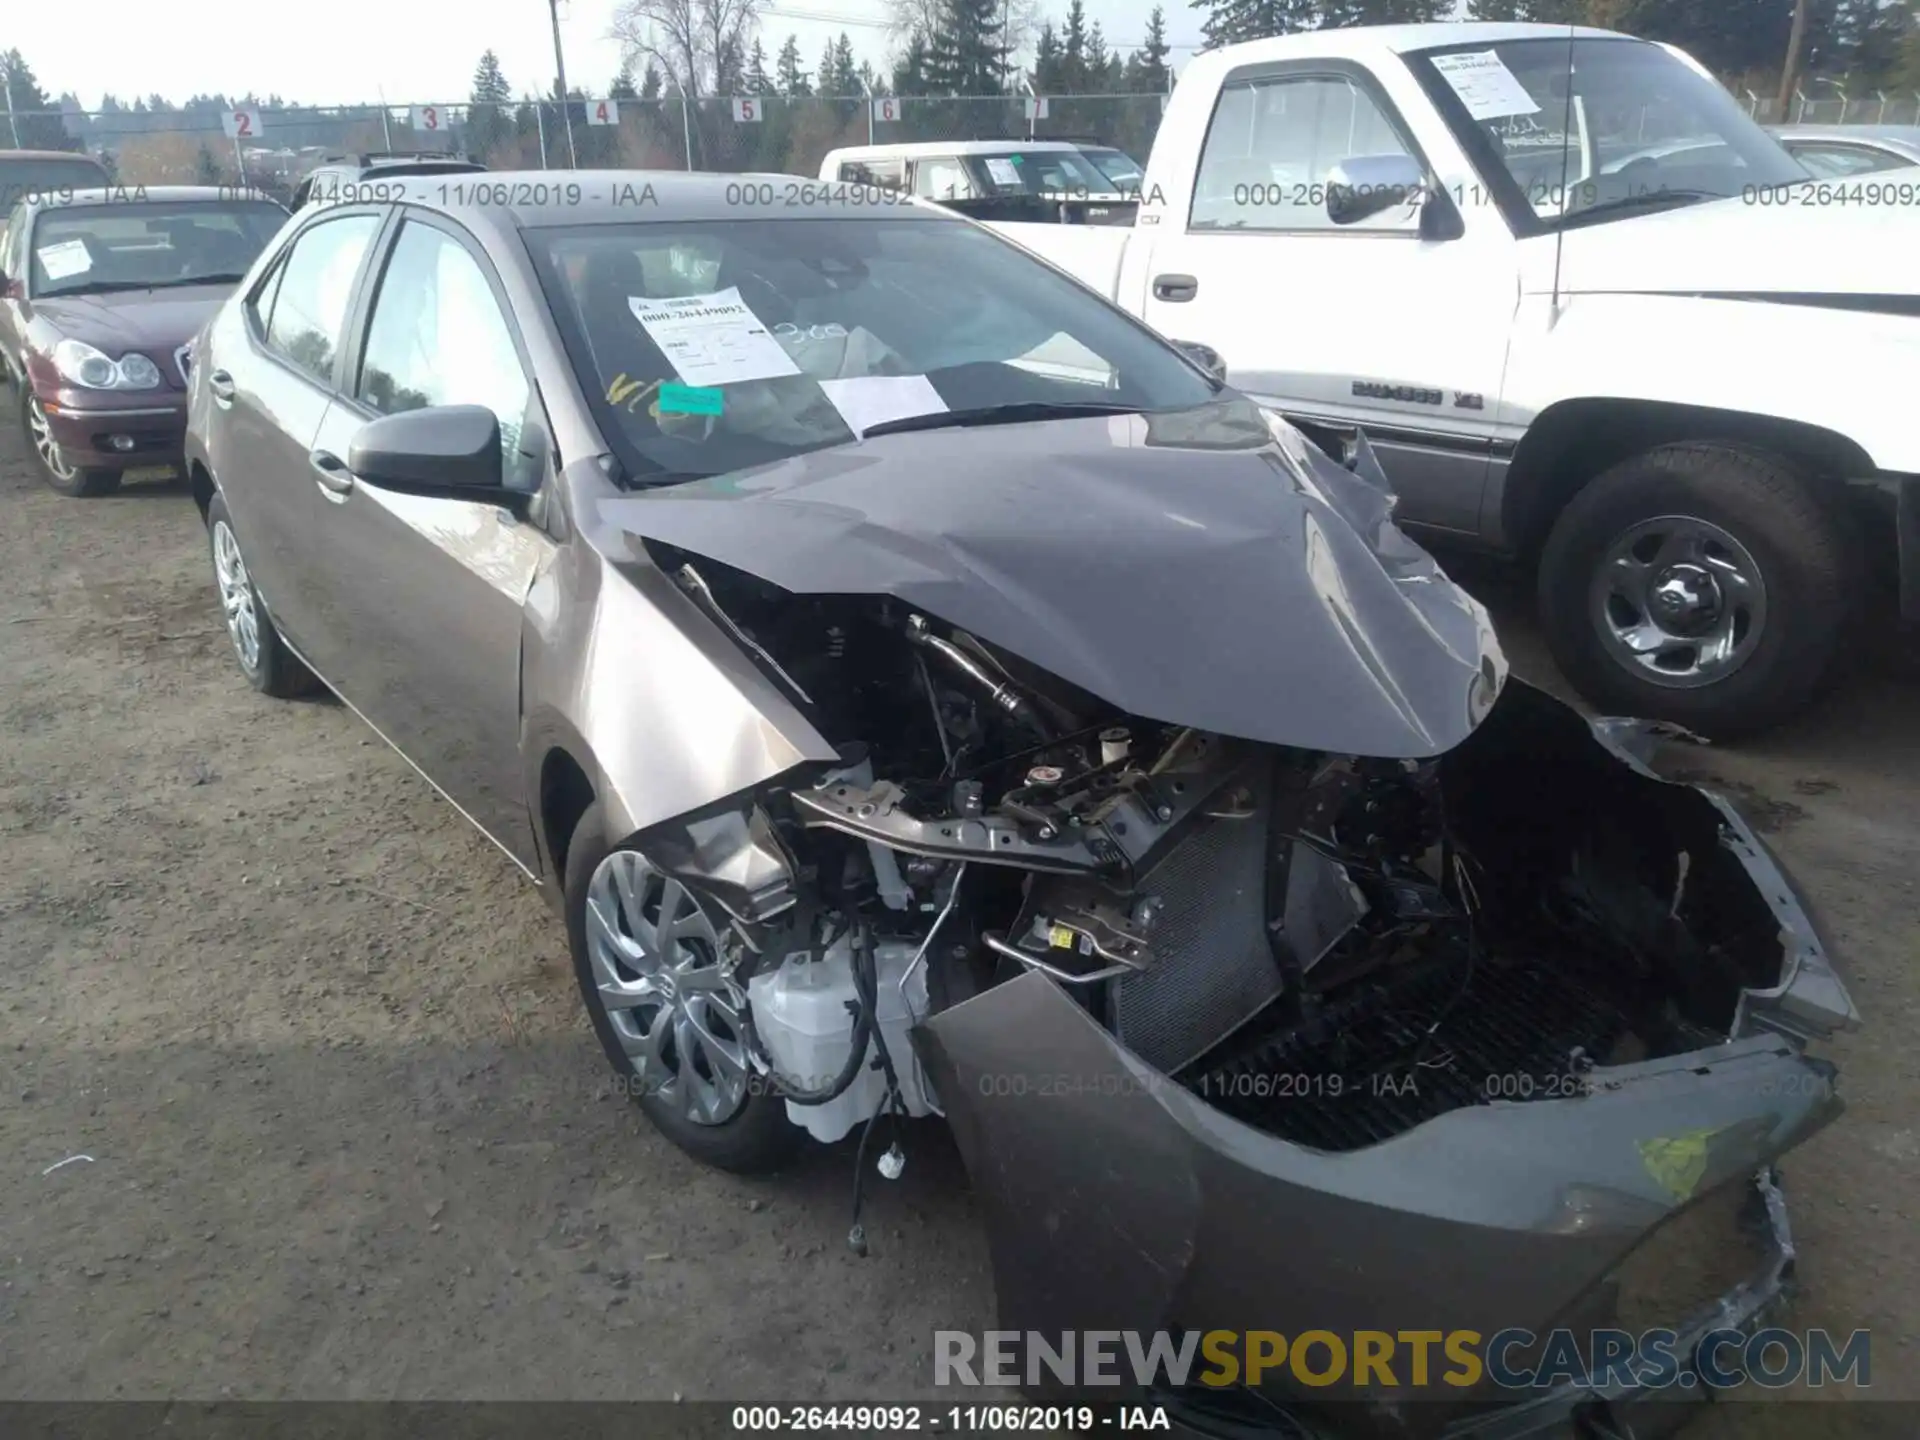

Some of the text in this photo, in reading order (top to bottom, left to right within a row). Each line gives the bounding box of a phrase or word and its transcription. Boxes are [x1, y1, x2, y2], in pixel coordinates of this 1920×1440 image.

[422, 107, 438, 131] 3
[595, 102, 610, 123] 4
[742, 100, 754, 121] 5
[882, 100, 894, 121] 6
[234, 112, 253, 137] 2
